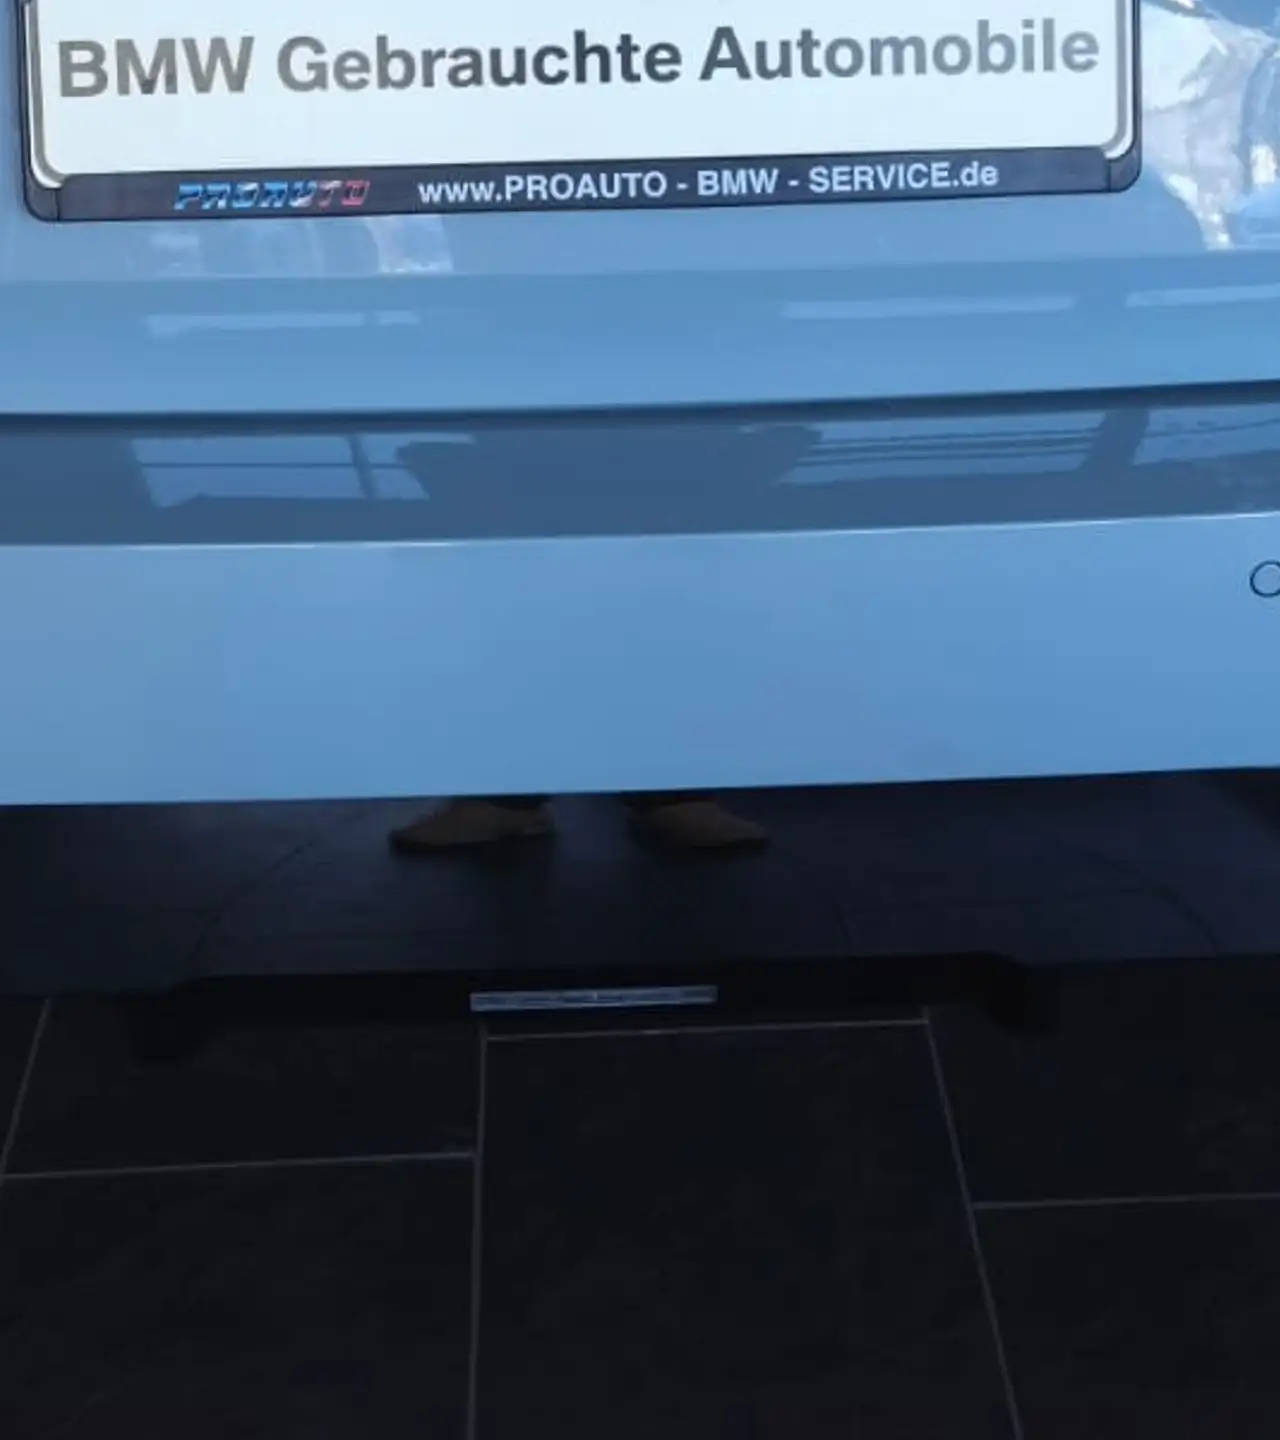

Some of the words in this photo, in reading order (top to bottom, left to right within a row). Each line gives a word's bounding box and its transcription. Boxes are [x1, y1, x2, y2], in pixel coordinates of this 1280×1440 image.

[58, 35, 255, 98] BMW
[276, 28, 683, 93] Gebrauchte
[698, 18, 1100, 83] Automobile
[417, 171, 668, 204] www.PROAUTO
[697, 168, 780, 196] BMW
[808, 159, 1000, 194] SERVICE.de
